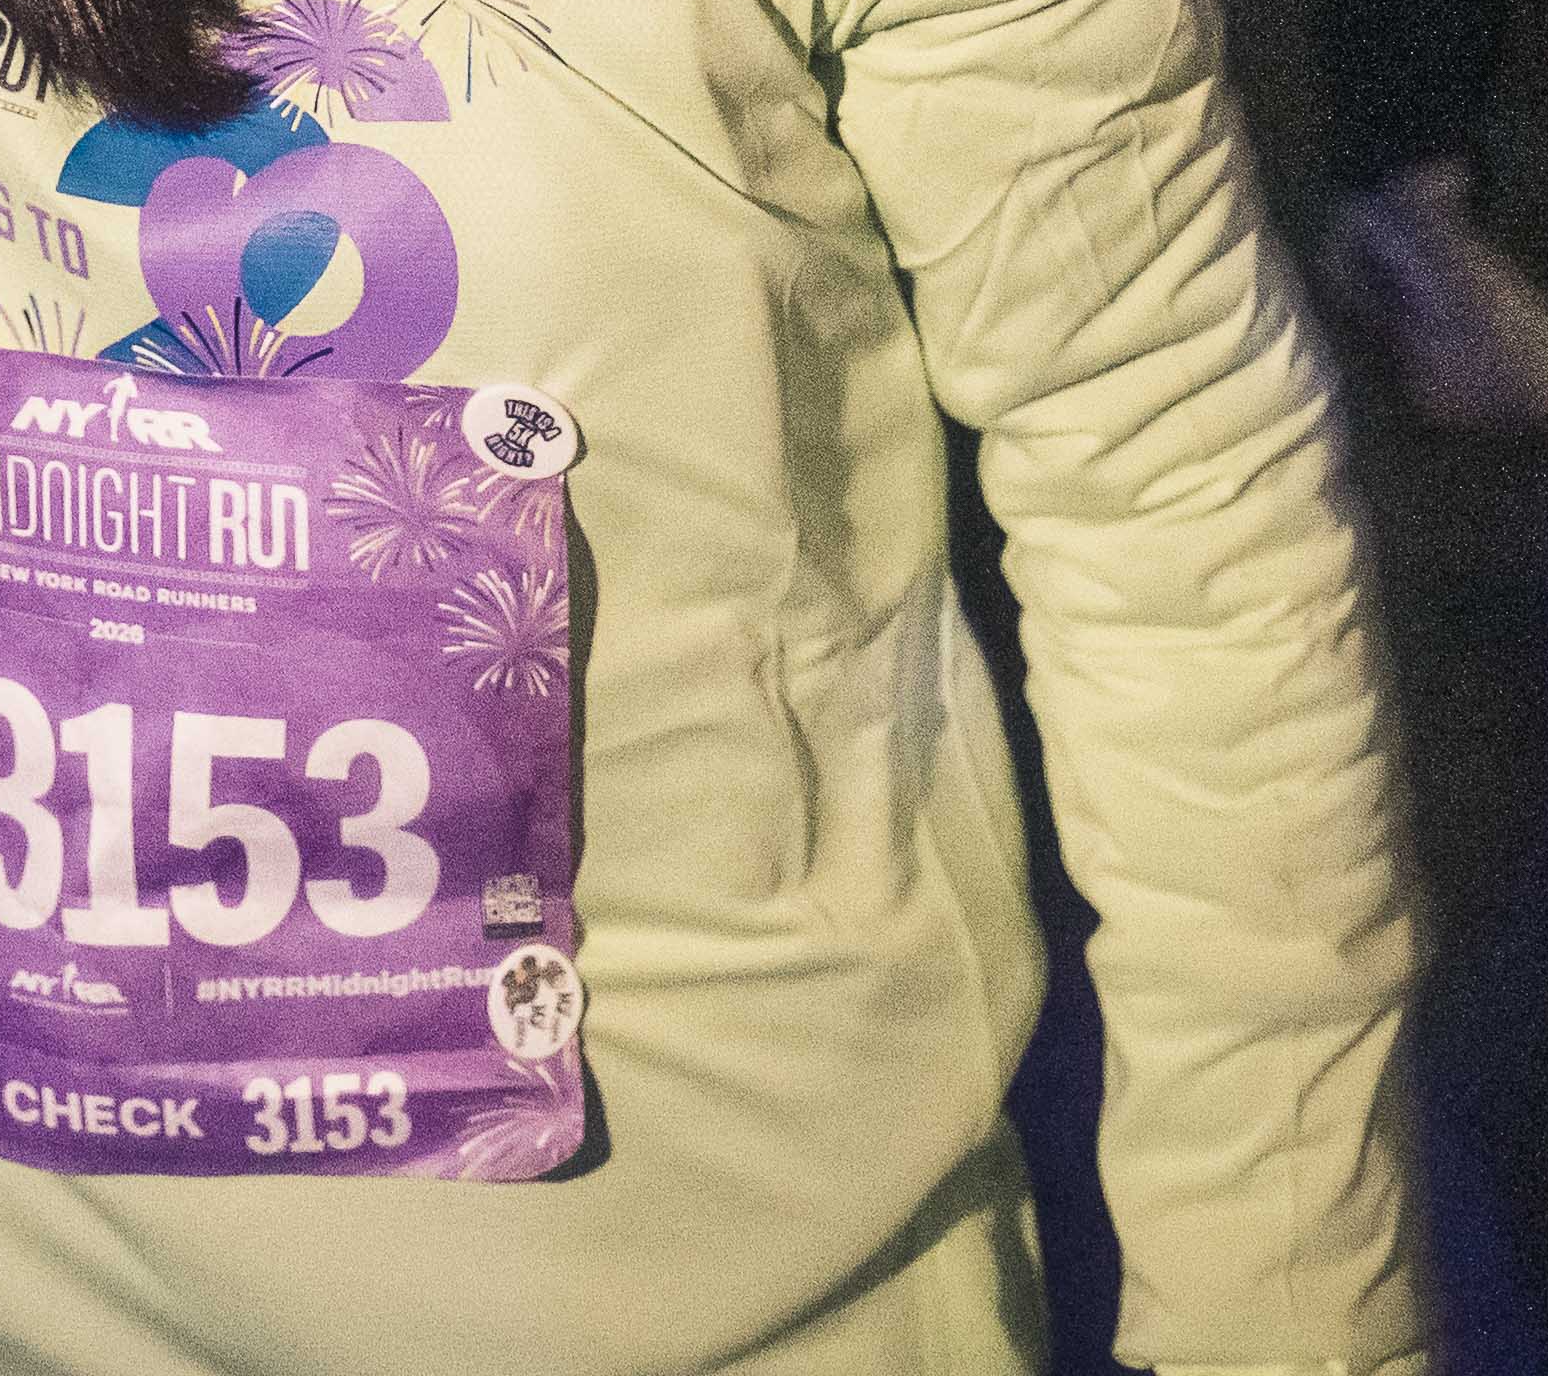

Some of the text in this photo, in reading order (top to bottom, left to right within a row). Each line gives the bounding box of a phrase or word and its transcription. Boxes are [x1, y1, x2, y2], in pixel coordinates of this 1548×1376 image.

[24, 200, 89, 280] TO
[208, 478, 311, 572] RUN
[34, 569, 88, 593] YORK
[92, 578, 151, 603] ROAD
[156, 587, 257, 613] RUNNERS
[2, 1079, 204, 1138] CHECK
[242, 1070, 412, 1156] 3153
